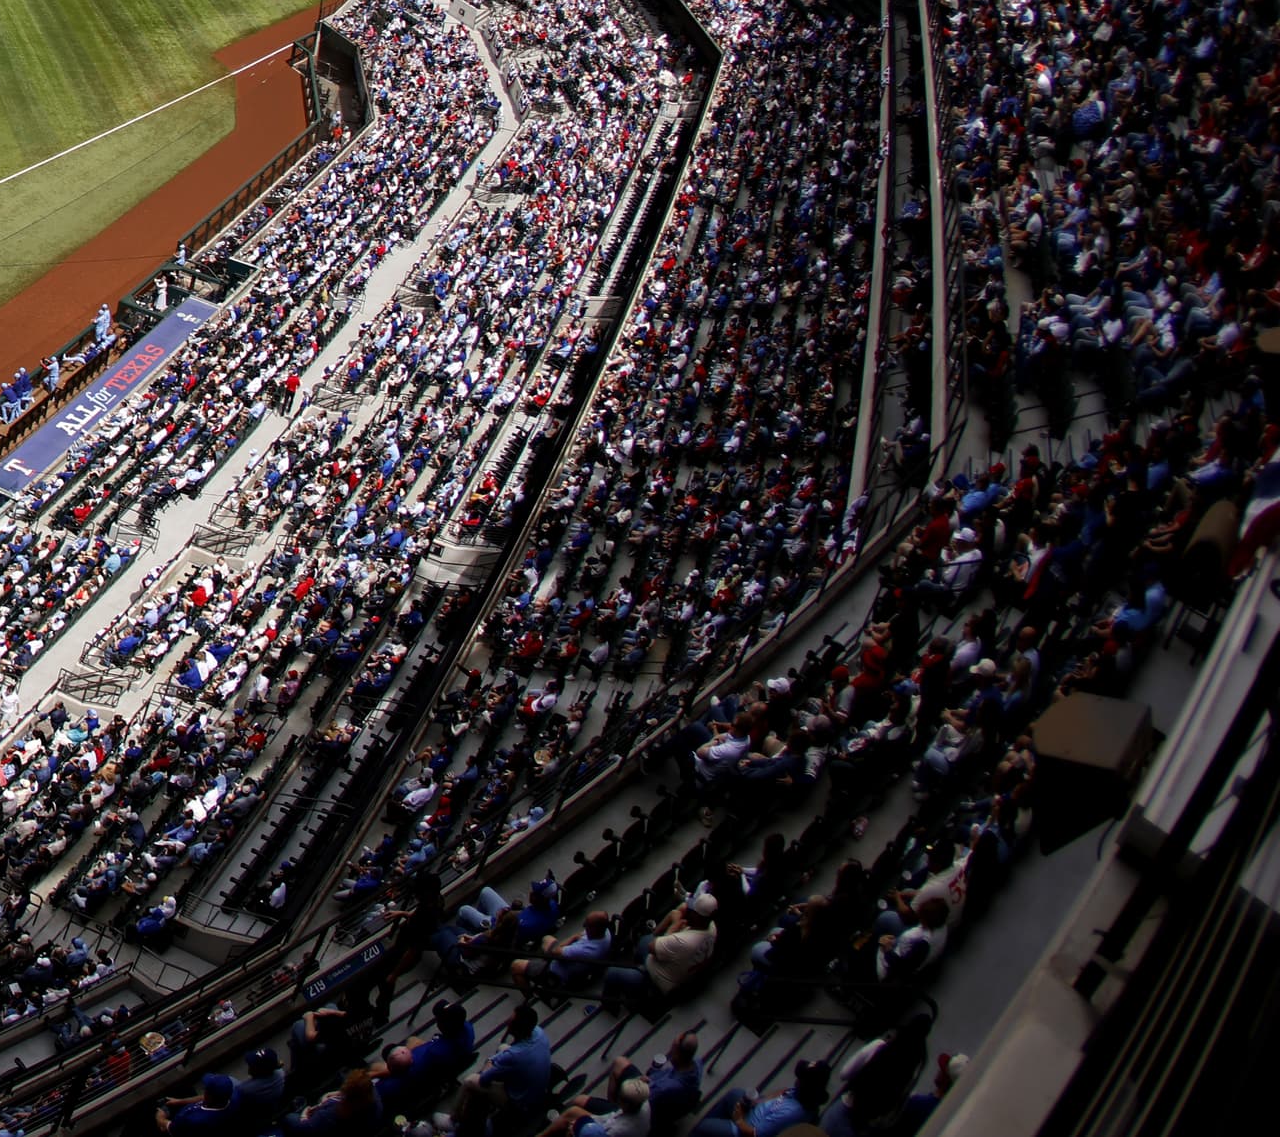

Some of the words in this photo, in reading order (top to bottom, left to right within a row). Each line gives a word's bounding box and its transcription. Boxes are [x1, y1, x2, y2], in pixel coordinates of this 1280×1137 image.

[56, 396, 99, 436] ALL
[88, 386, 116, 412] for
[105, 344, 165, 392] TEXAS
[3, 458, 37, 477] T
